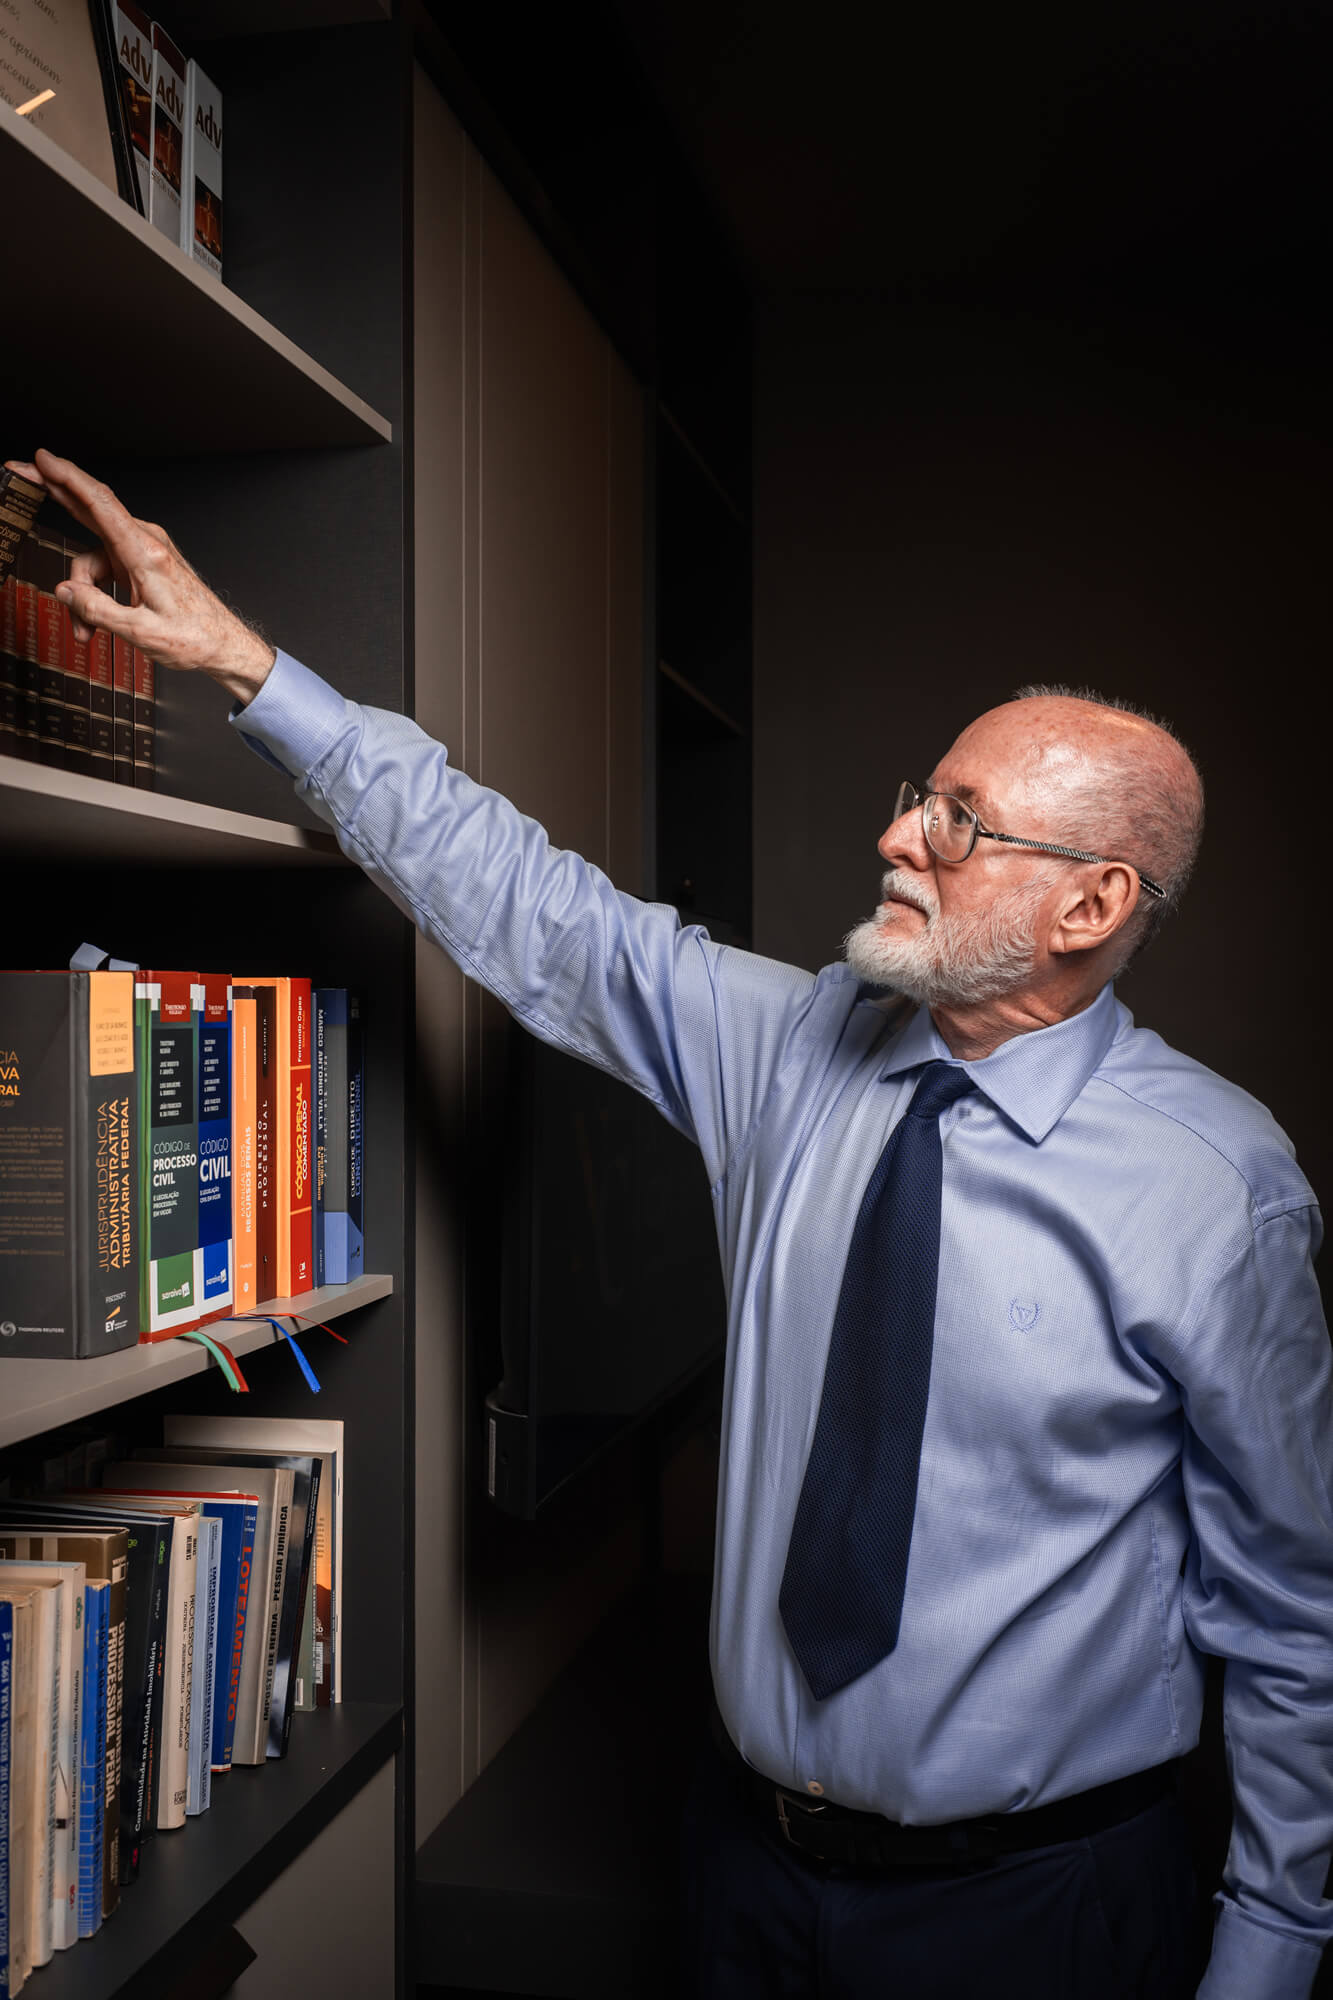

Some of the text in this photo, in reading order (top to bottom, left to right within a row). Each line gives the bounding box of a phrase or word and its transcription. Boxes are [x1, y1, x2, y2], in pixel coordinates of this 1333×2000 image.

[120, 35, 152, 84] Adv
[156, 75, 184, 123] Adv
[195, 105, 222, 149] Adv
[153, 1153, 197, 1171] PROCESSO
[154, 1140, 183, 1155] CÓDIGO
[200, 1137, 229, 1155] CÓDIGO
[295, 1083, 303, 1200] CÓDIGO PENAL
[96, 1101, 110, 1272] JURISPRUDÊNCIA
[109, 1099, 121, 1269] ADMINISTRATIVA
[120, 1097, 130, 1268] TRIBUTÁRIA FEDERAL
[153, 1172, 176, 1187] CIVIL
[200, 1155, 231, 1182] CIVIL
[105, 1320, 115, 1333] EY
[188, 1594, 196, 1657] PROCESSO
[227, 1546, 252, 1721] LOTEAMENTO
[263, 1506, 288, 1721] IMPOSTO DE RENDA PESSOA JURÍDICA
[146, 1641, 157, 1696] Imobiliária
[186, 1661, 193, 1675] DE
[1, 1686, 9, 1719] PARA
[106, 1625, 119, 1808] PROCESSUAL PENAL
[115, 1620, 125, 1785] CURSO DE DIREITO
[142, 1697, 152, 1746] Atividade
[205, 1651, 213, 1750] ADMINISTRATIVA
[142, 1747, 147, 1760] na
[135, 1761, 146, 1832] Contabilidade
